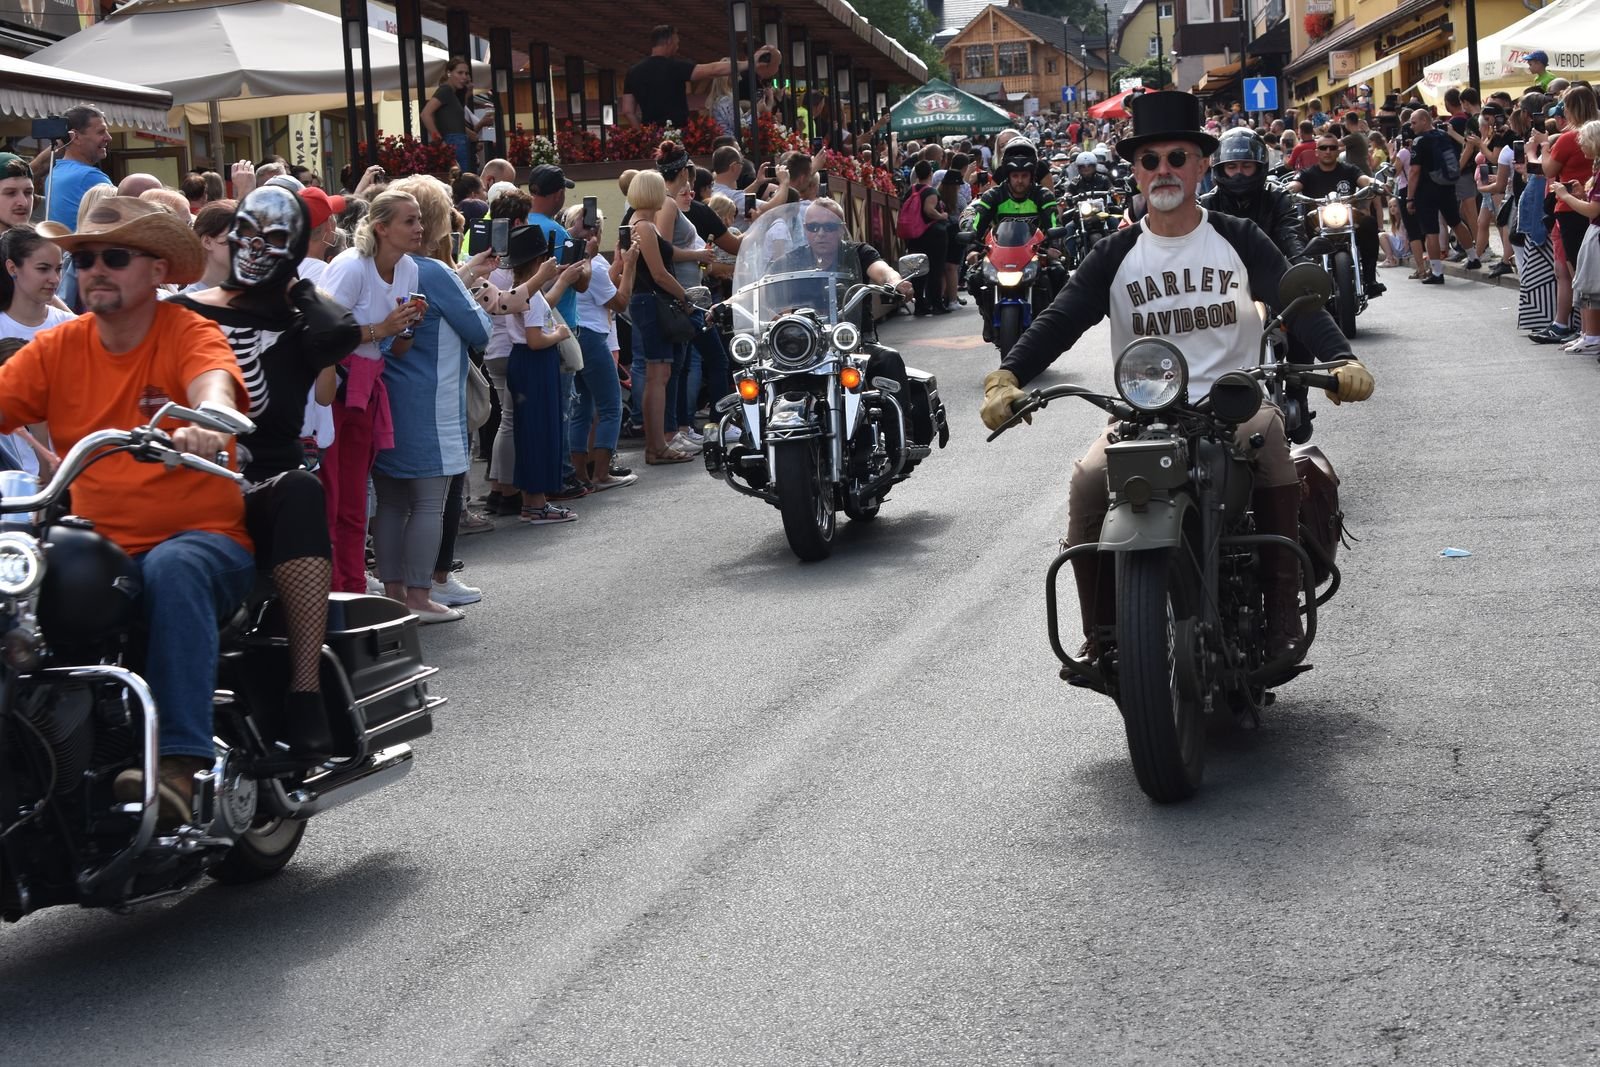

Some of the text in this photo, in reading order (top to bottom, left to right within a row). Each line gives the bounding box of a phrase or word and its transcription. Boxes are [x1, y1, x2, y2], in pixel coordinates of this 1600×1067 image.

[1554, 53, 1585, 68] VERDE
[901, 113, 977, 126] ROHOZEC
[295, 130, 305, 166] WAR
[1126, 267, 1239, 307] HARLEY-
[1132, 301, 1237, 336] DAVIDSON
